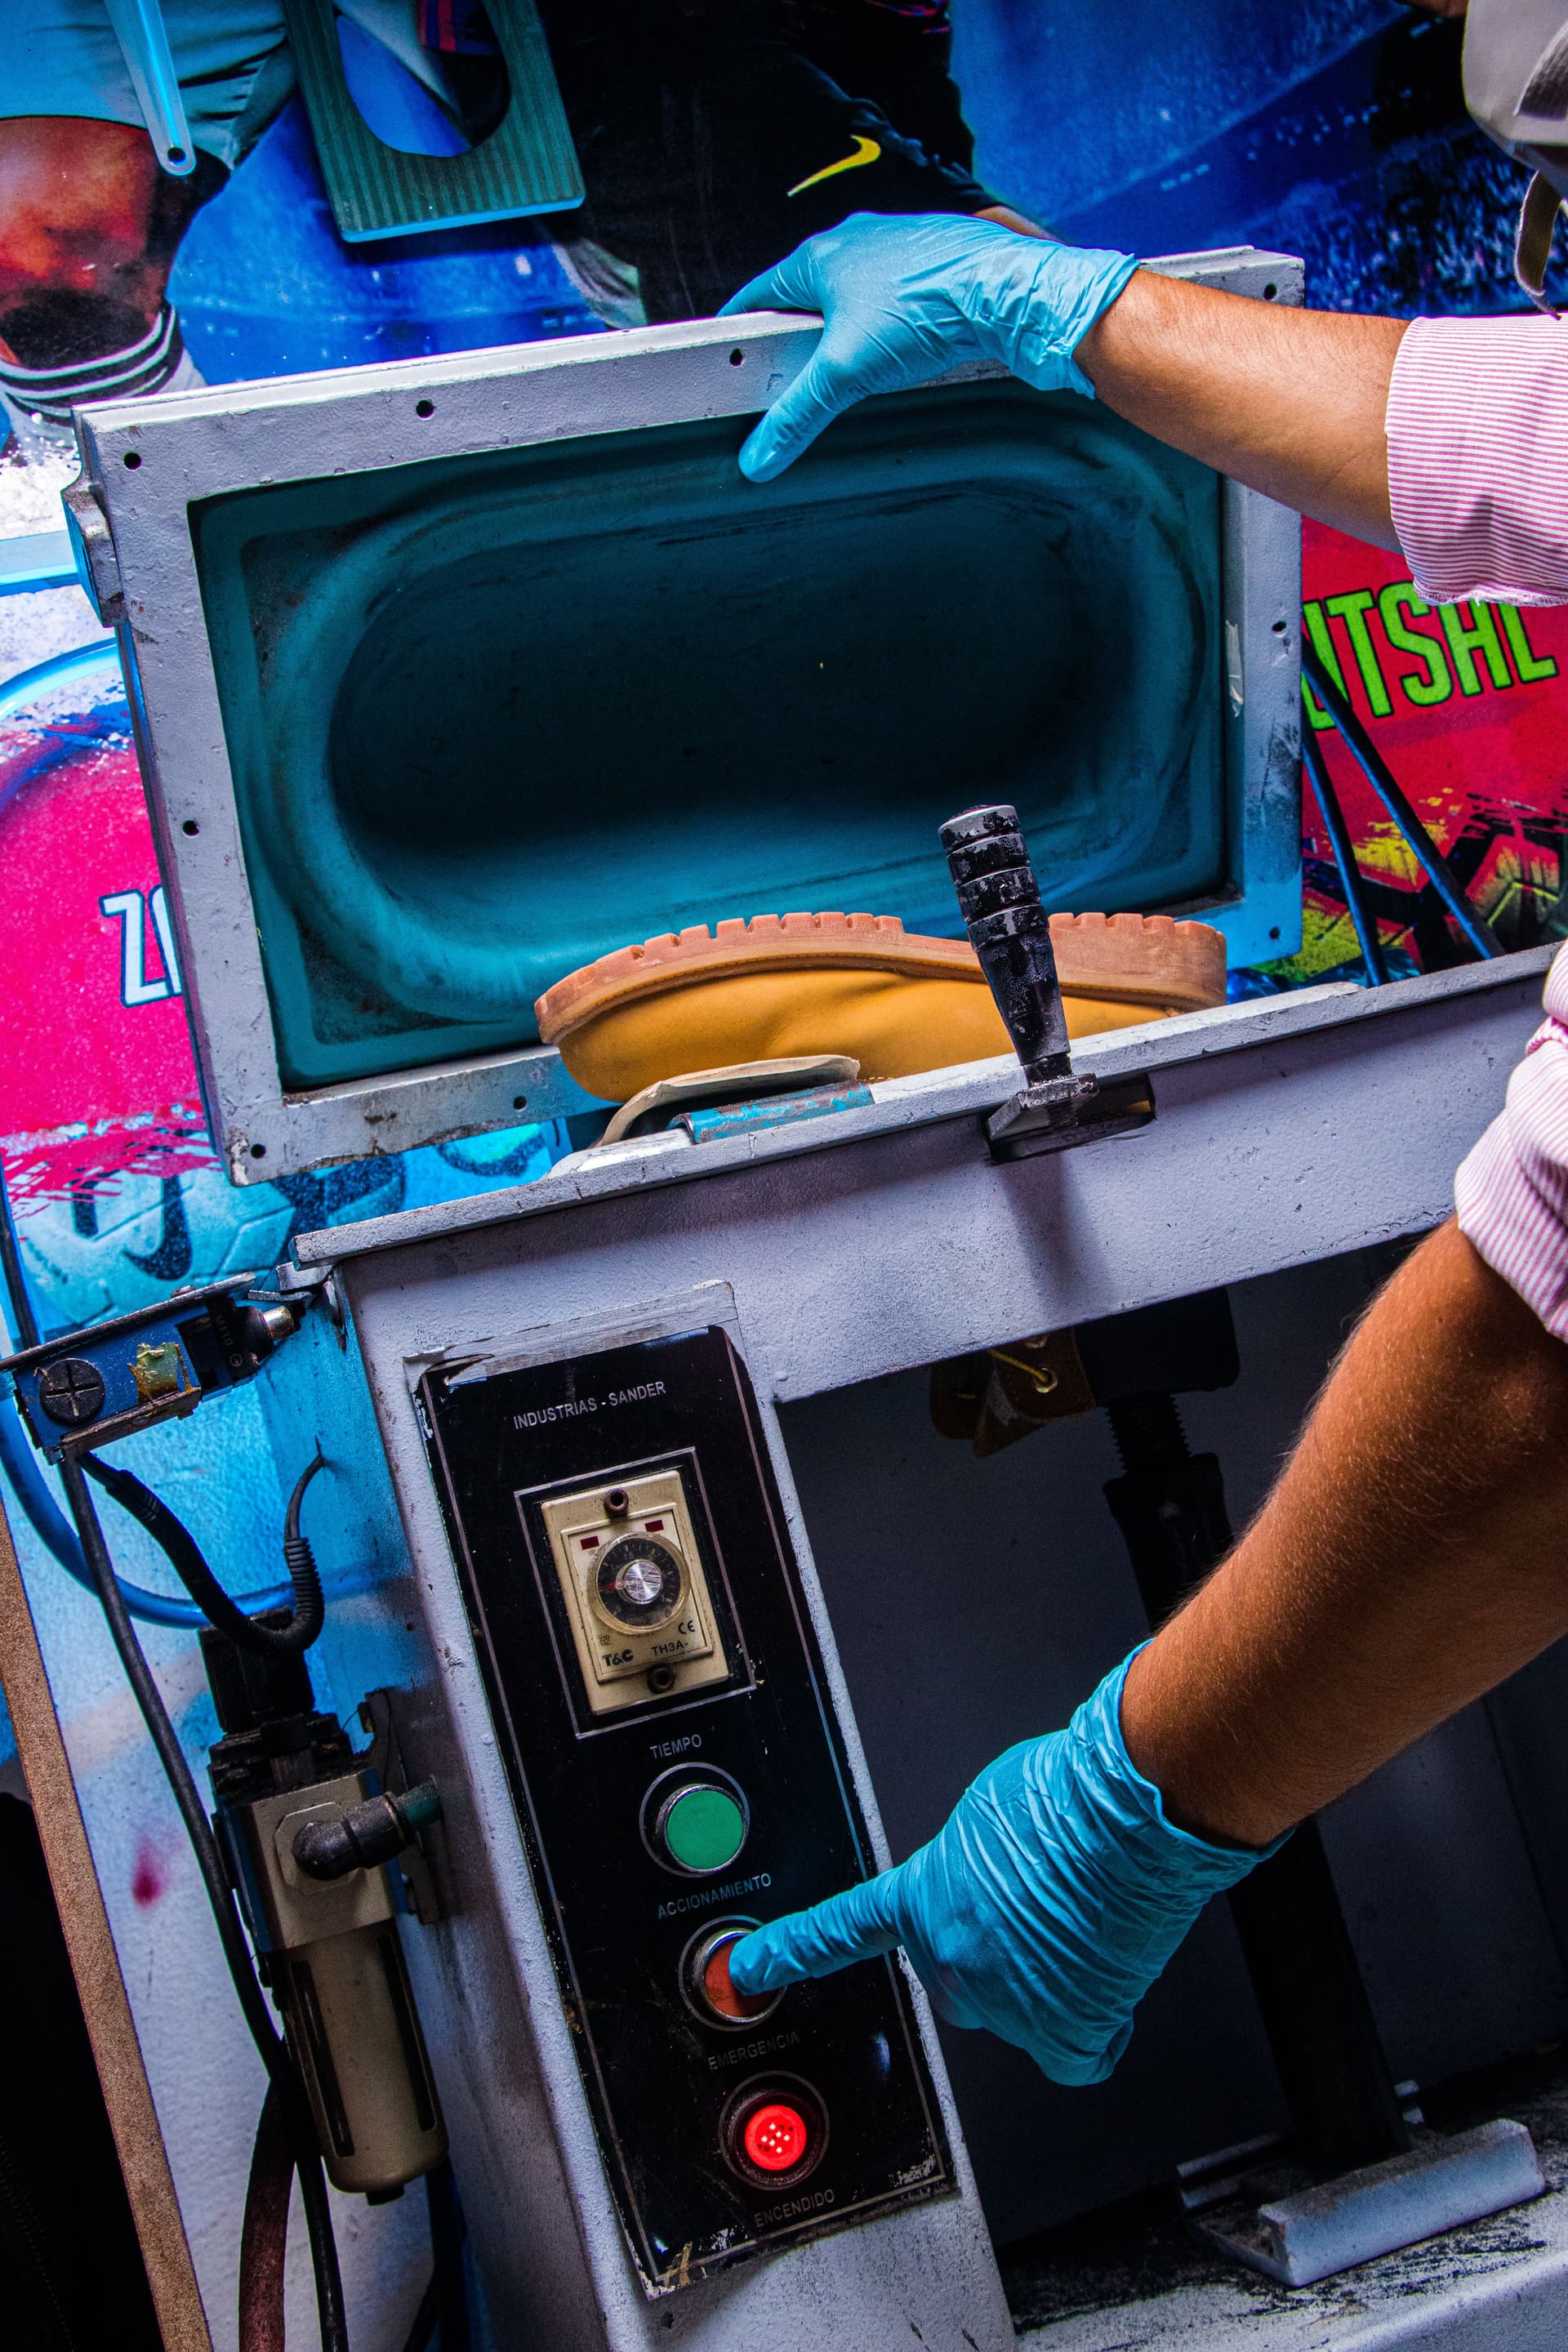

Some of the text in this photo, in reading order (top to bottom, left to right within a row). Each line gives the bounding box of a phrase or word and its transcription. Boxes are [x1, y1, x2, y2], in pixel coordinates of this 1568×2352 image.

[513, 1397, 597, 1429] INDUSTRIAS
[608, 1380, 666, 1406] SANDER
[602, 1649, 634, 1666] T&C
[649, 1734, 702, 1759] TIEMPO
[657, 1873, 772, 1919] ACCIONAMIENTO
[708, 2031, 800, 2070] EMERGENCIA
[754, 2189, 835, 2228] ENCENDIDO
